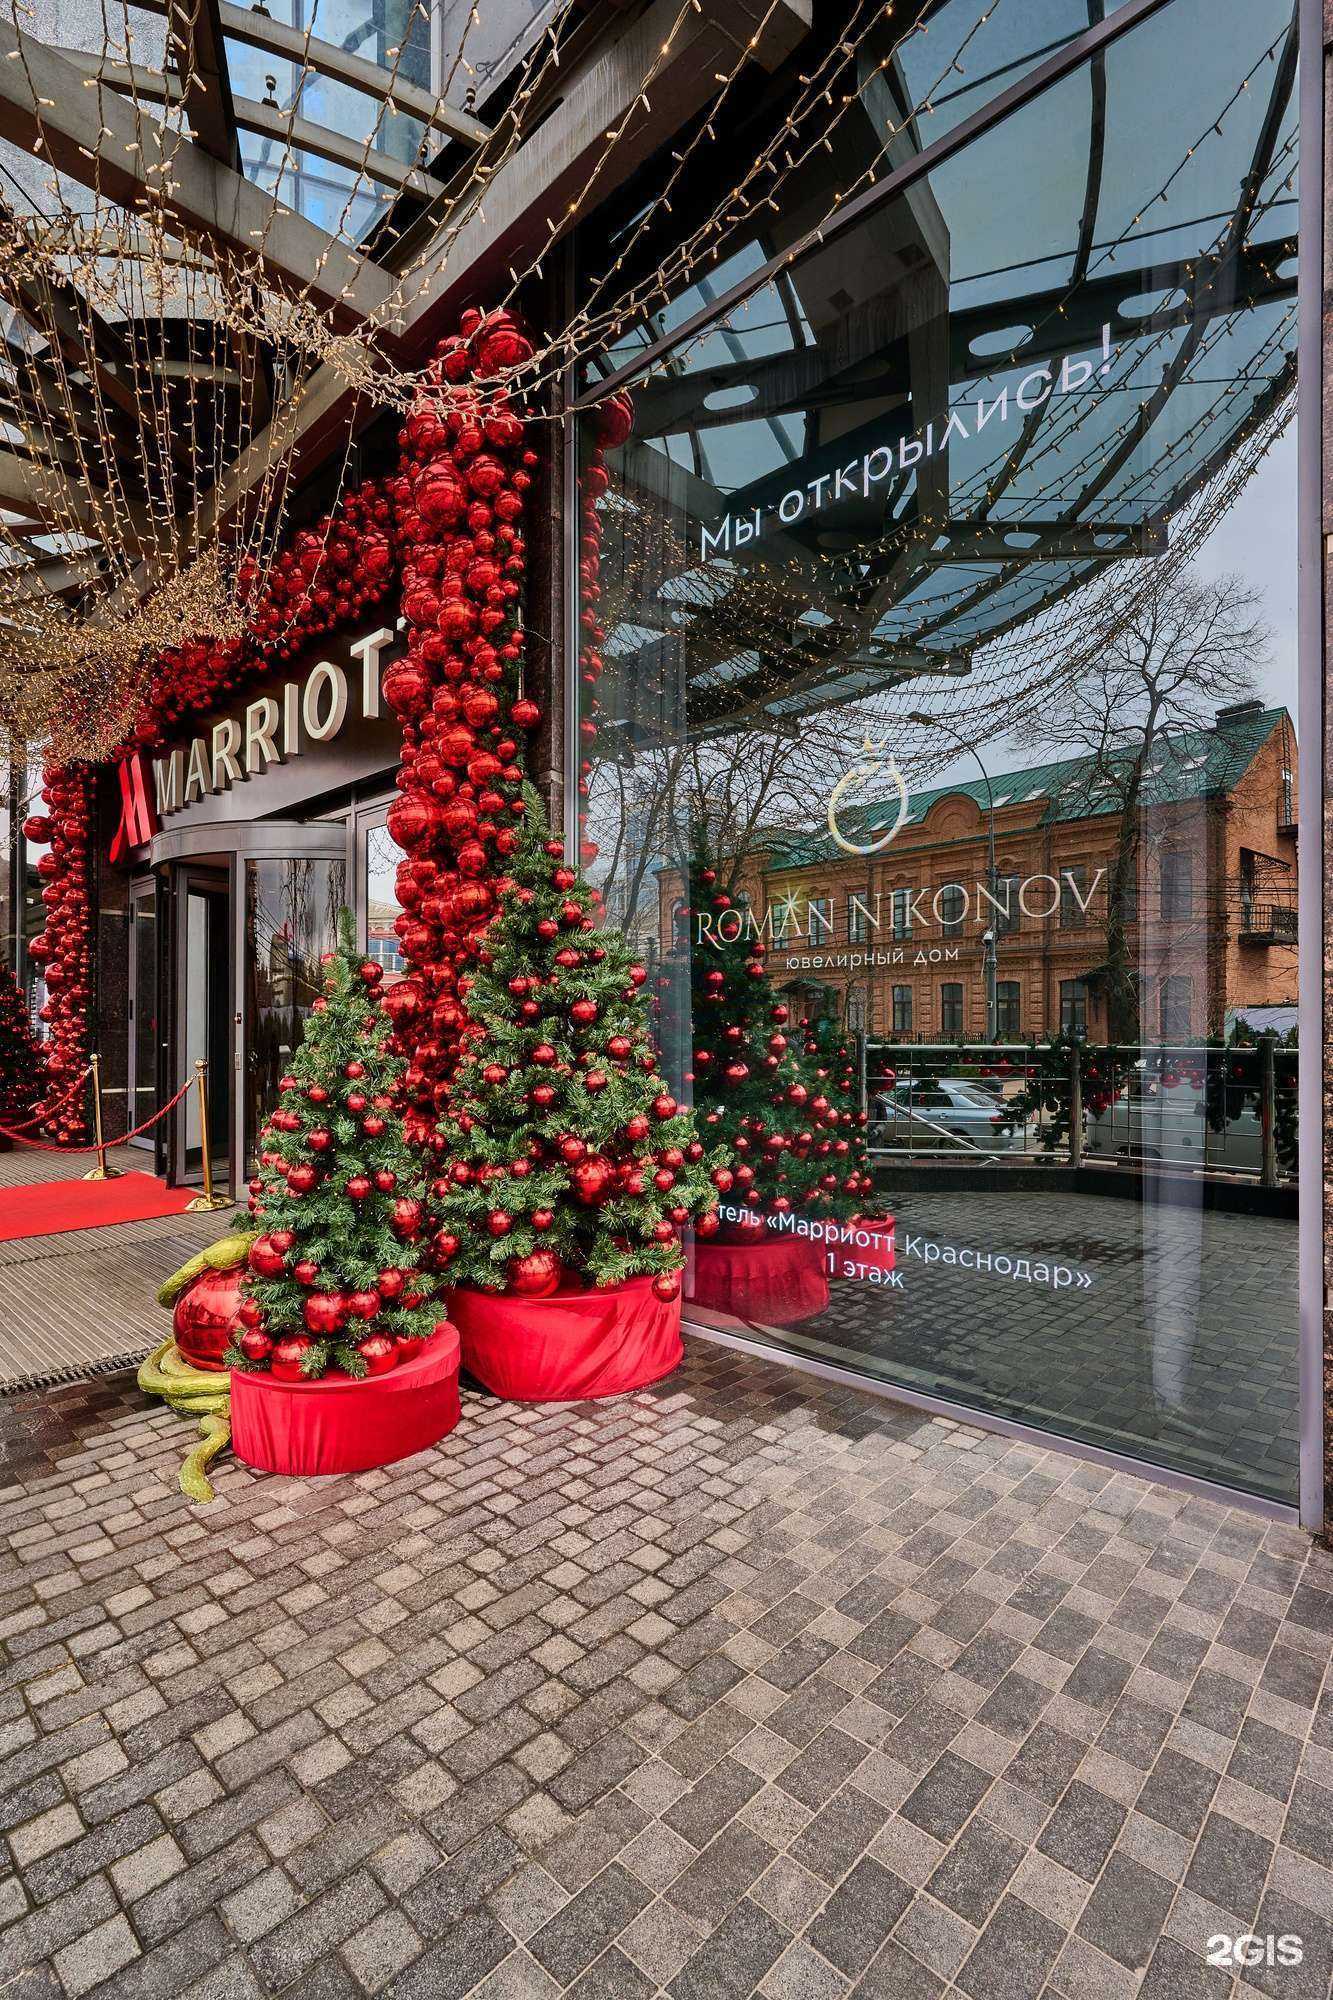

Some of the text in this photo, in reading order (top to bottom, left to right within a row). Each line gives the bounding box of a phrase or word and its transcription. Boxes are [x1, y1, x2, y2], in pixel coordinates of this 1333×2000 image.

[701, 322, 1111, 562] Мы открылись!
[153, 616, 407, 816] MARRIOT
[696, 868, 1109, 951] ROMAN NIKONOV
[786, 947, 960, 971] ювелирный дом
[719, 1204, 1093, 1290] тель «Марриотт Краснодар»
[826, 1251, 904, 1290] 1 этаж
